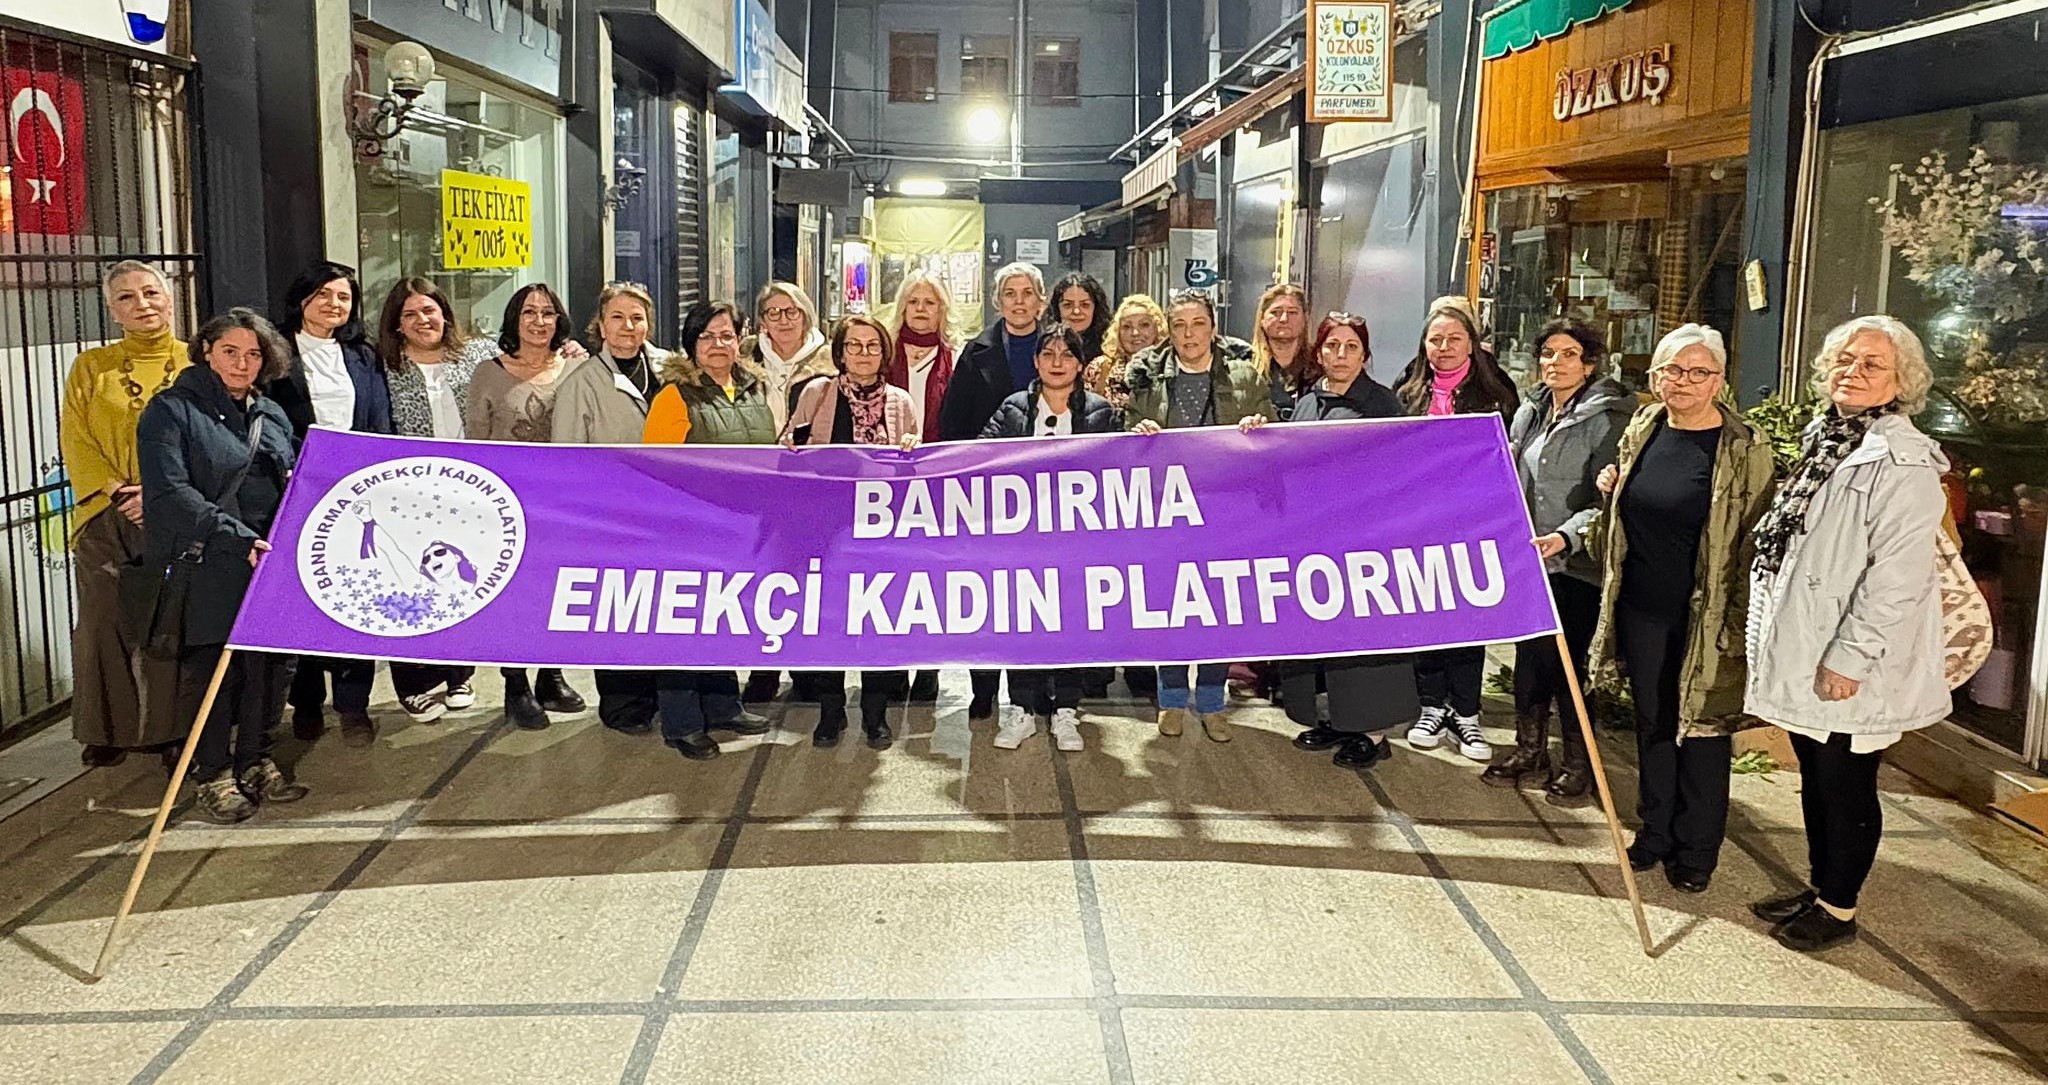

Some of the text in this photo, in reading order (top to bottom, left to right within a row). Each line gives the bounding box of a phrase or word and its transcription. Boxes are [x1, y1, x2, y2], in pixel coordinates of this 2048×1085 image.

[1553, 43, 1671, 120] ÖZKUŞ
[448, 184, 526, 223] TEK FİYAT
[311, 463, 518, 601] BANDIRMA EMEKÇİ KADIN PLATFORMU
[852, 463, 1205, 540] BANDIRMA
[546, 538, 1507, 655] EMEKÇİ KADIN PLATFORMU
